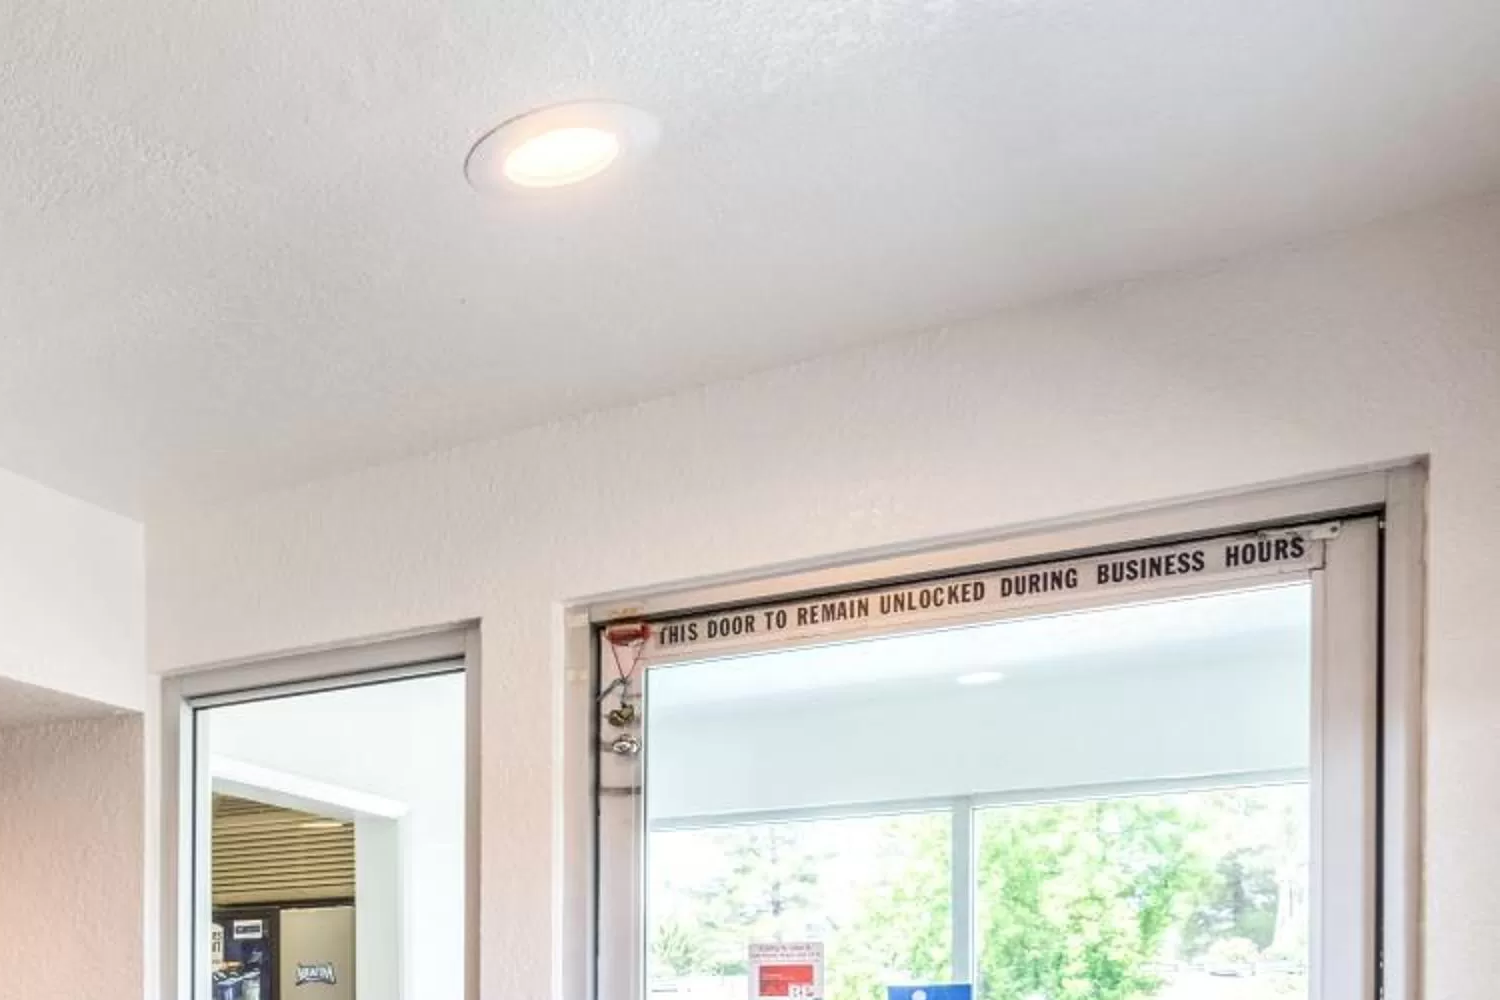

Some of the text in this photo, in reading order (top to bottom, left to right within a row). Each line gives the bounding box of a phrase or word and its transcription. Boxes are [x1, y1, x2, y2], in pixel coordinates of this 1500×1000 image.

[659, 536, 1305, 645] THIS DOOR TO REMAIN UNLOCKED DURING BUSINESS HOURS
